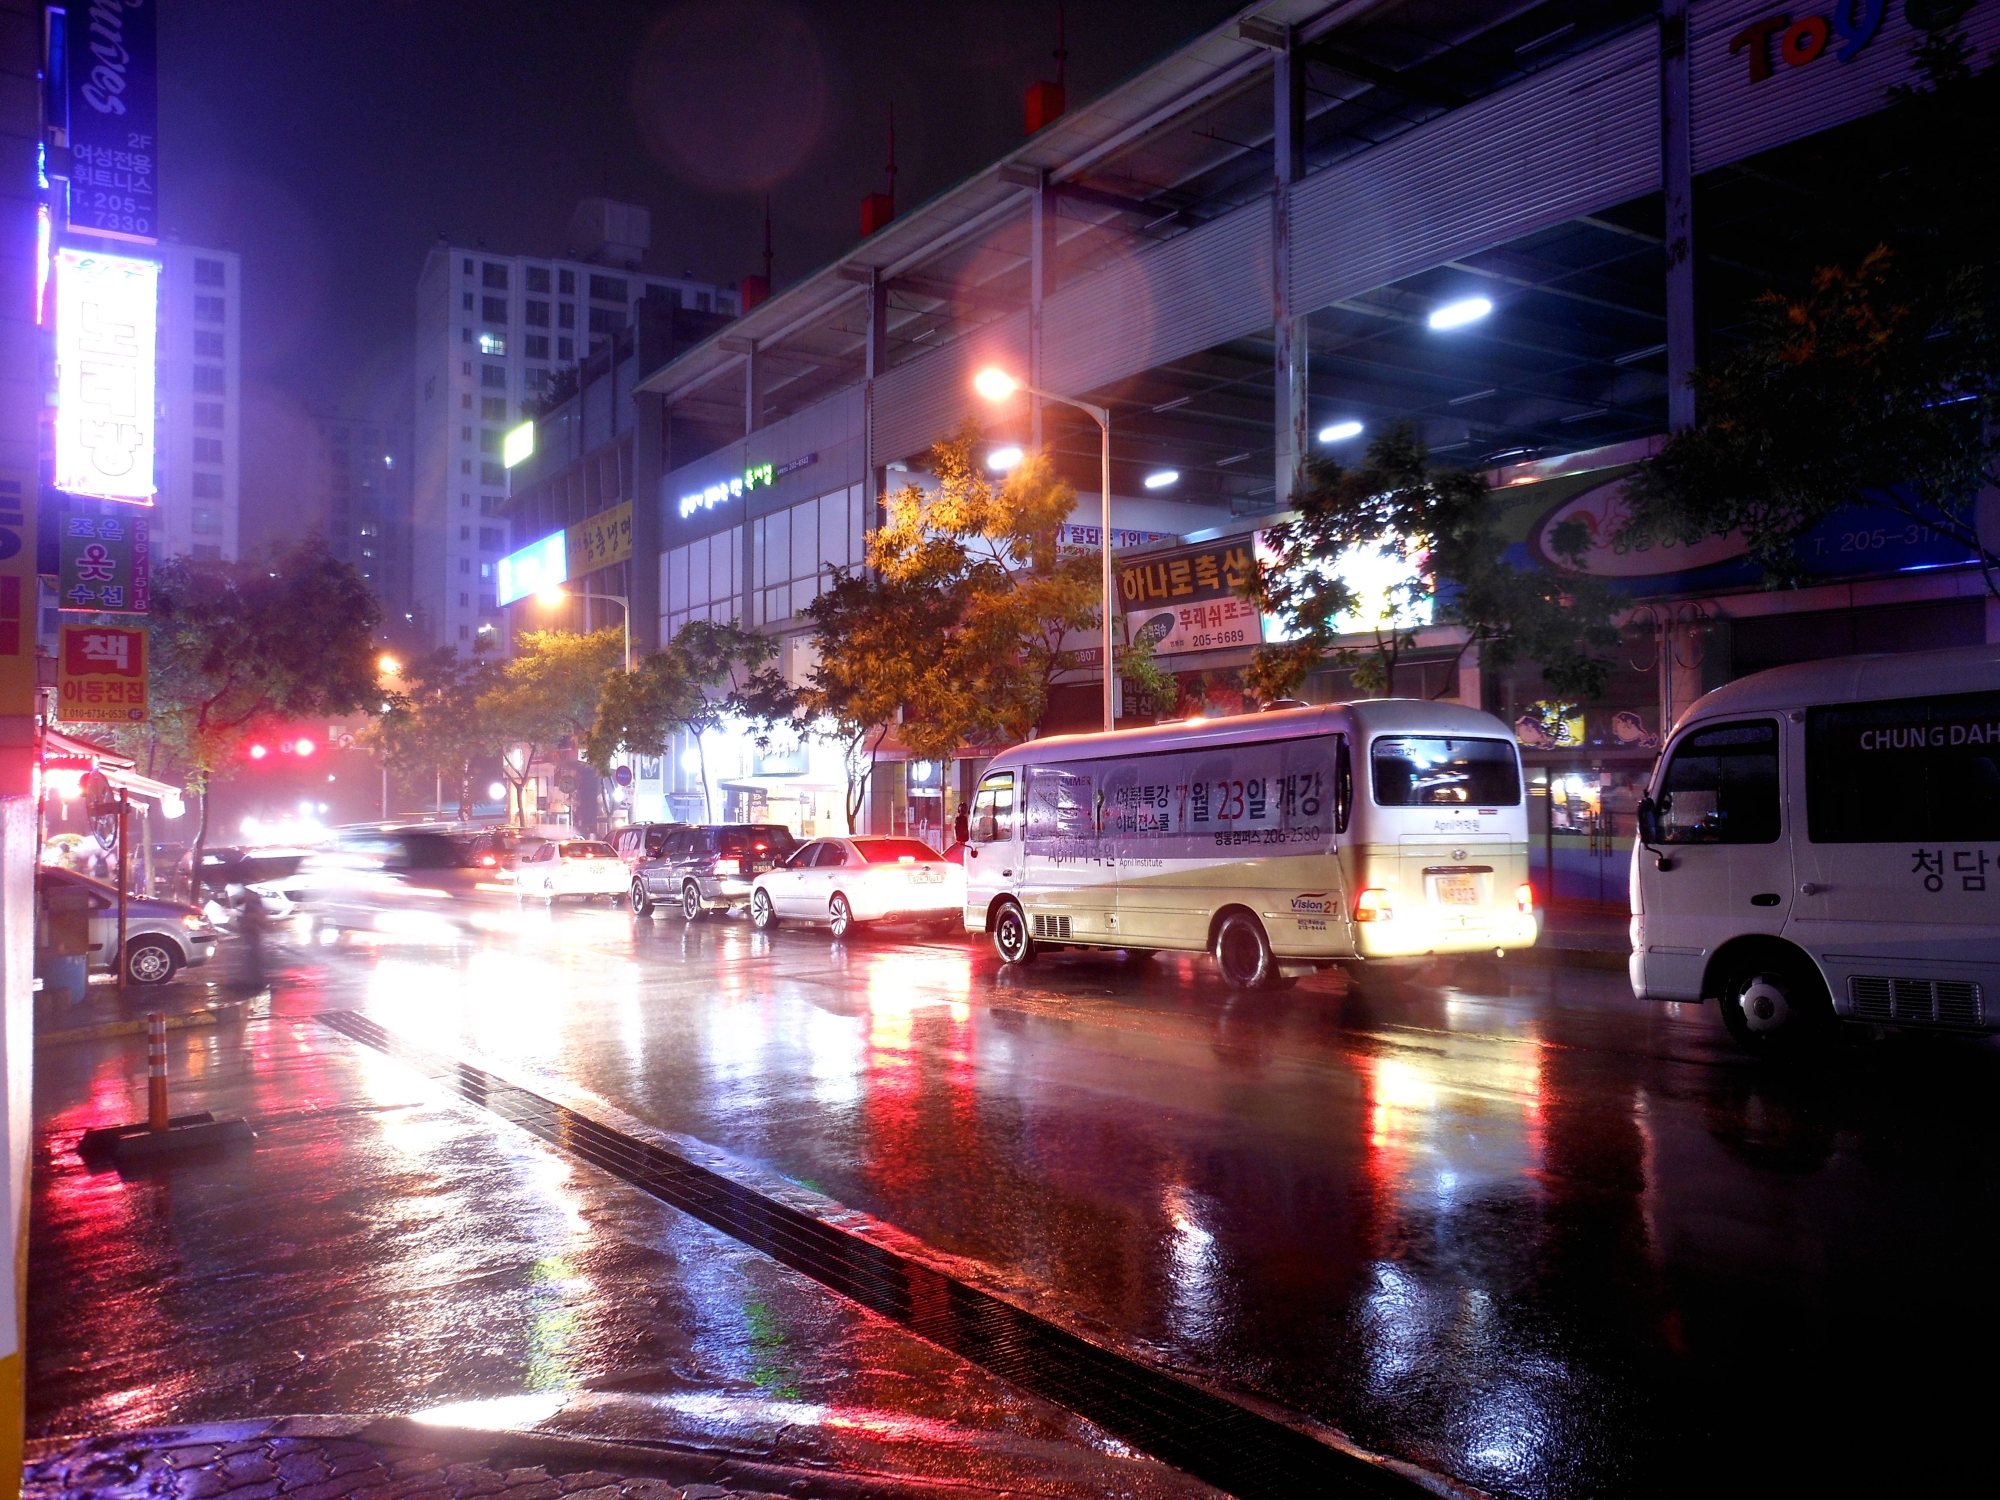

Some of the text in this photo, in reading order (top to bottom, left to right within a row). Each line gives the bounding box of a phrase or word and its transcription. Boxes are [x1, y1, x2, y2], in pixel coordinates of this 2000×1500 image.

[81, 0, 142, 115] urves
[127, 132, 153, 149] 2F
[73, 143, 153, 175] 여성전용
[73, 164, 153, 195] 휘트니스
[93, 210, 150, 234] 7330
[67, 517, 125, 541] 조은
[75, 542, 116, 582] 옷
[134, 520, 148, 610] 206/1518
[1122, 547, 1248, 602] 하나로축산
[67, 583, 124, 607] 수선
[1192, 630, 1244, 648] 205-6689
[81, 634, 129, 669] 책
[63, 680, 144, 704] 아동전집
[1860, 726, 1944, 750] CHUNG
[1276, 772, 1323, 817] 개강
[1263, 825, 1321, 845] 206-2580
[1119, 857, 1163, 869] April Institute
[1911, 849, 2000, 893] 청담
[1290, 898, 1338, 914] Vision 21
